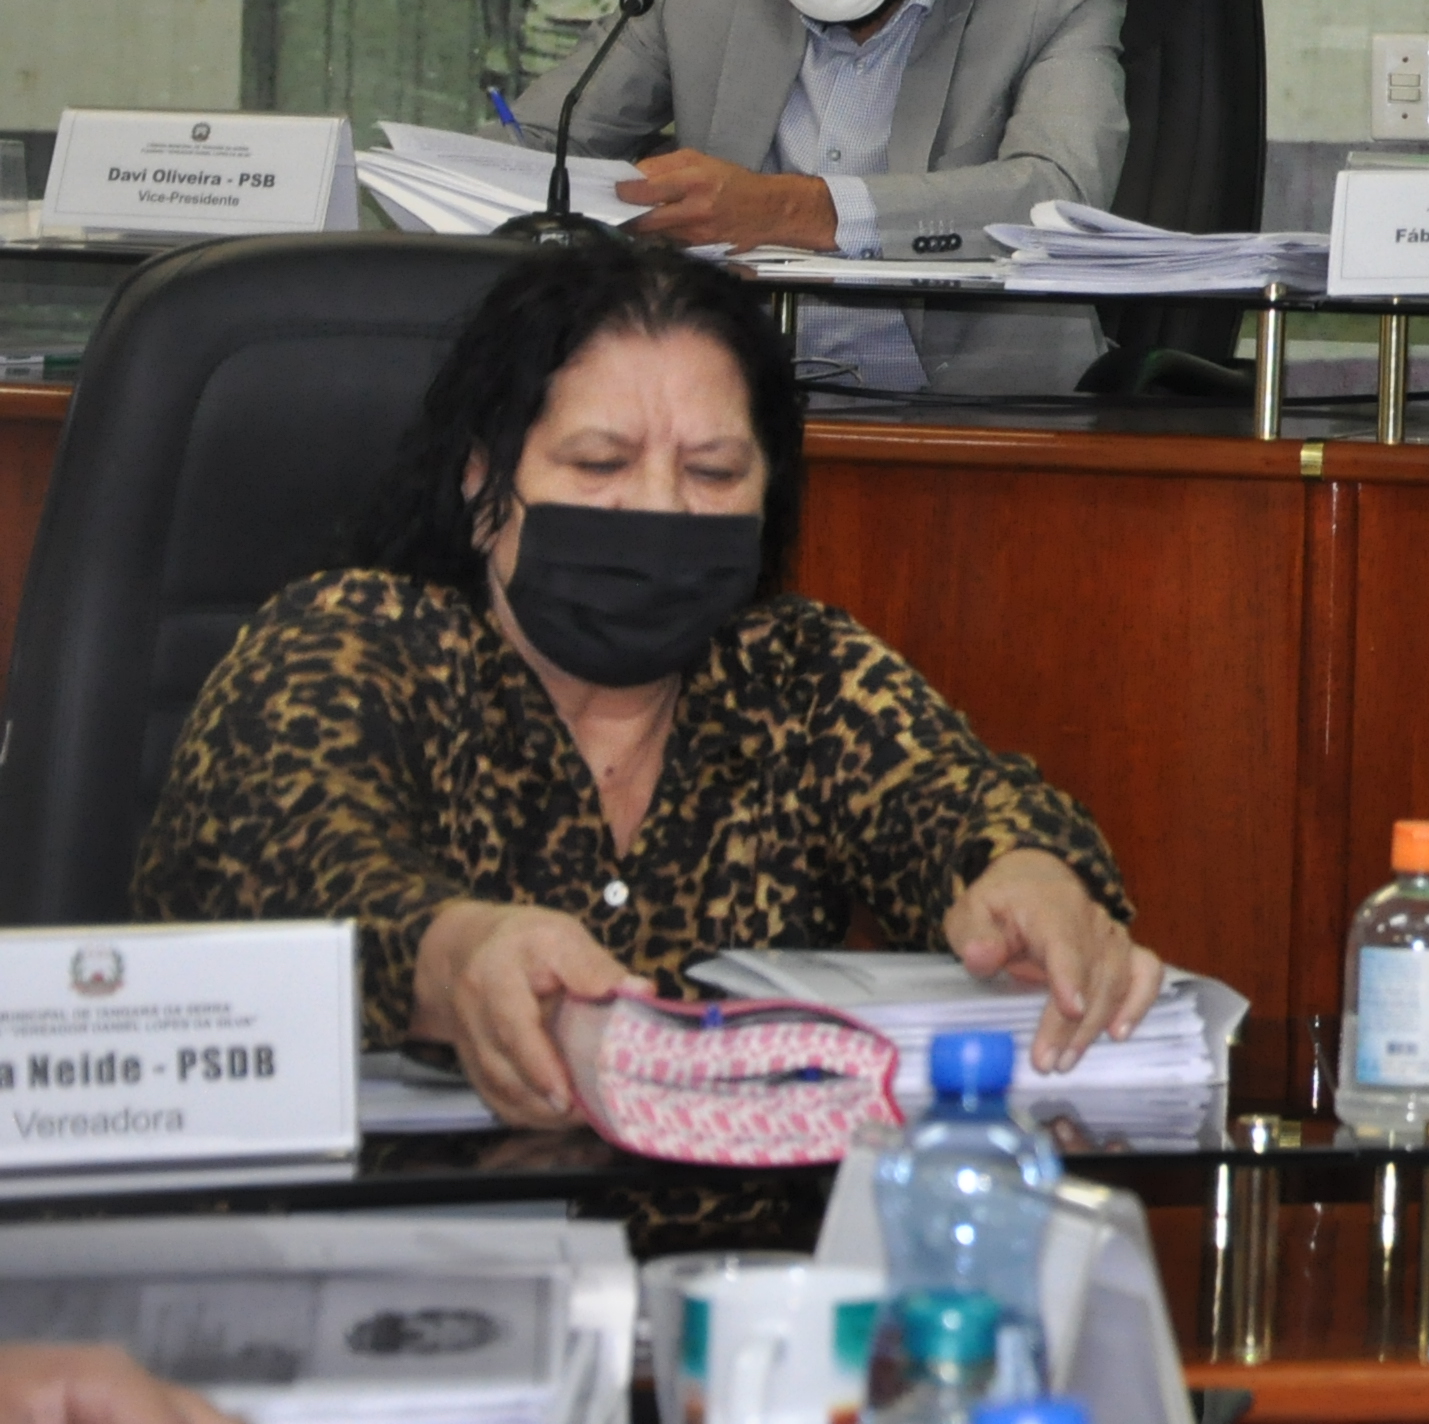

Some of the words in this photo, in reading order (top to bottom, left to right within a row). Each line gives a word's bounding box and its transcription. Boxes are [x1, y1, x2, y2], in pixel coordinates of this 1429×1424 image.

[107, 166, 148, 184] Davi
[152, 168, 222, 187] Oliveira
[239, 172, 276, 189] PSB
[138, 189, 240, 208] Vice-Presidente
[29, 1050, 142, 1089] Neide
[177, 1044, 277, 1082] PSDB
[14, 1108, 184, 1139] Vereadora
